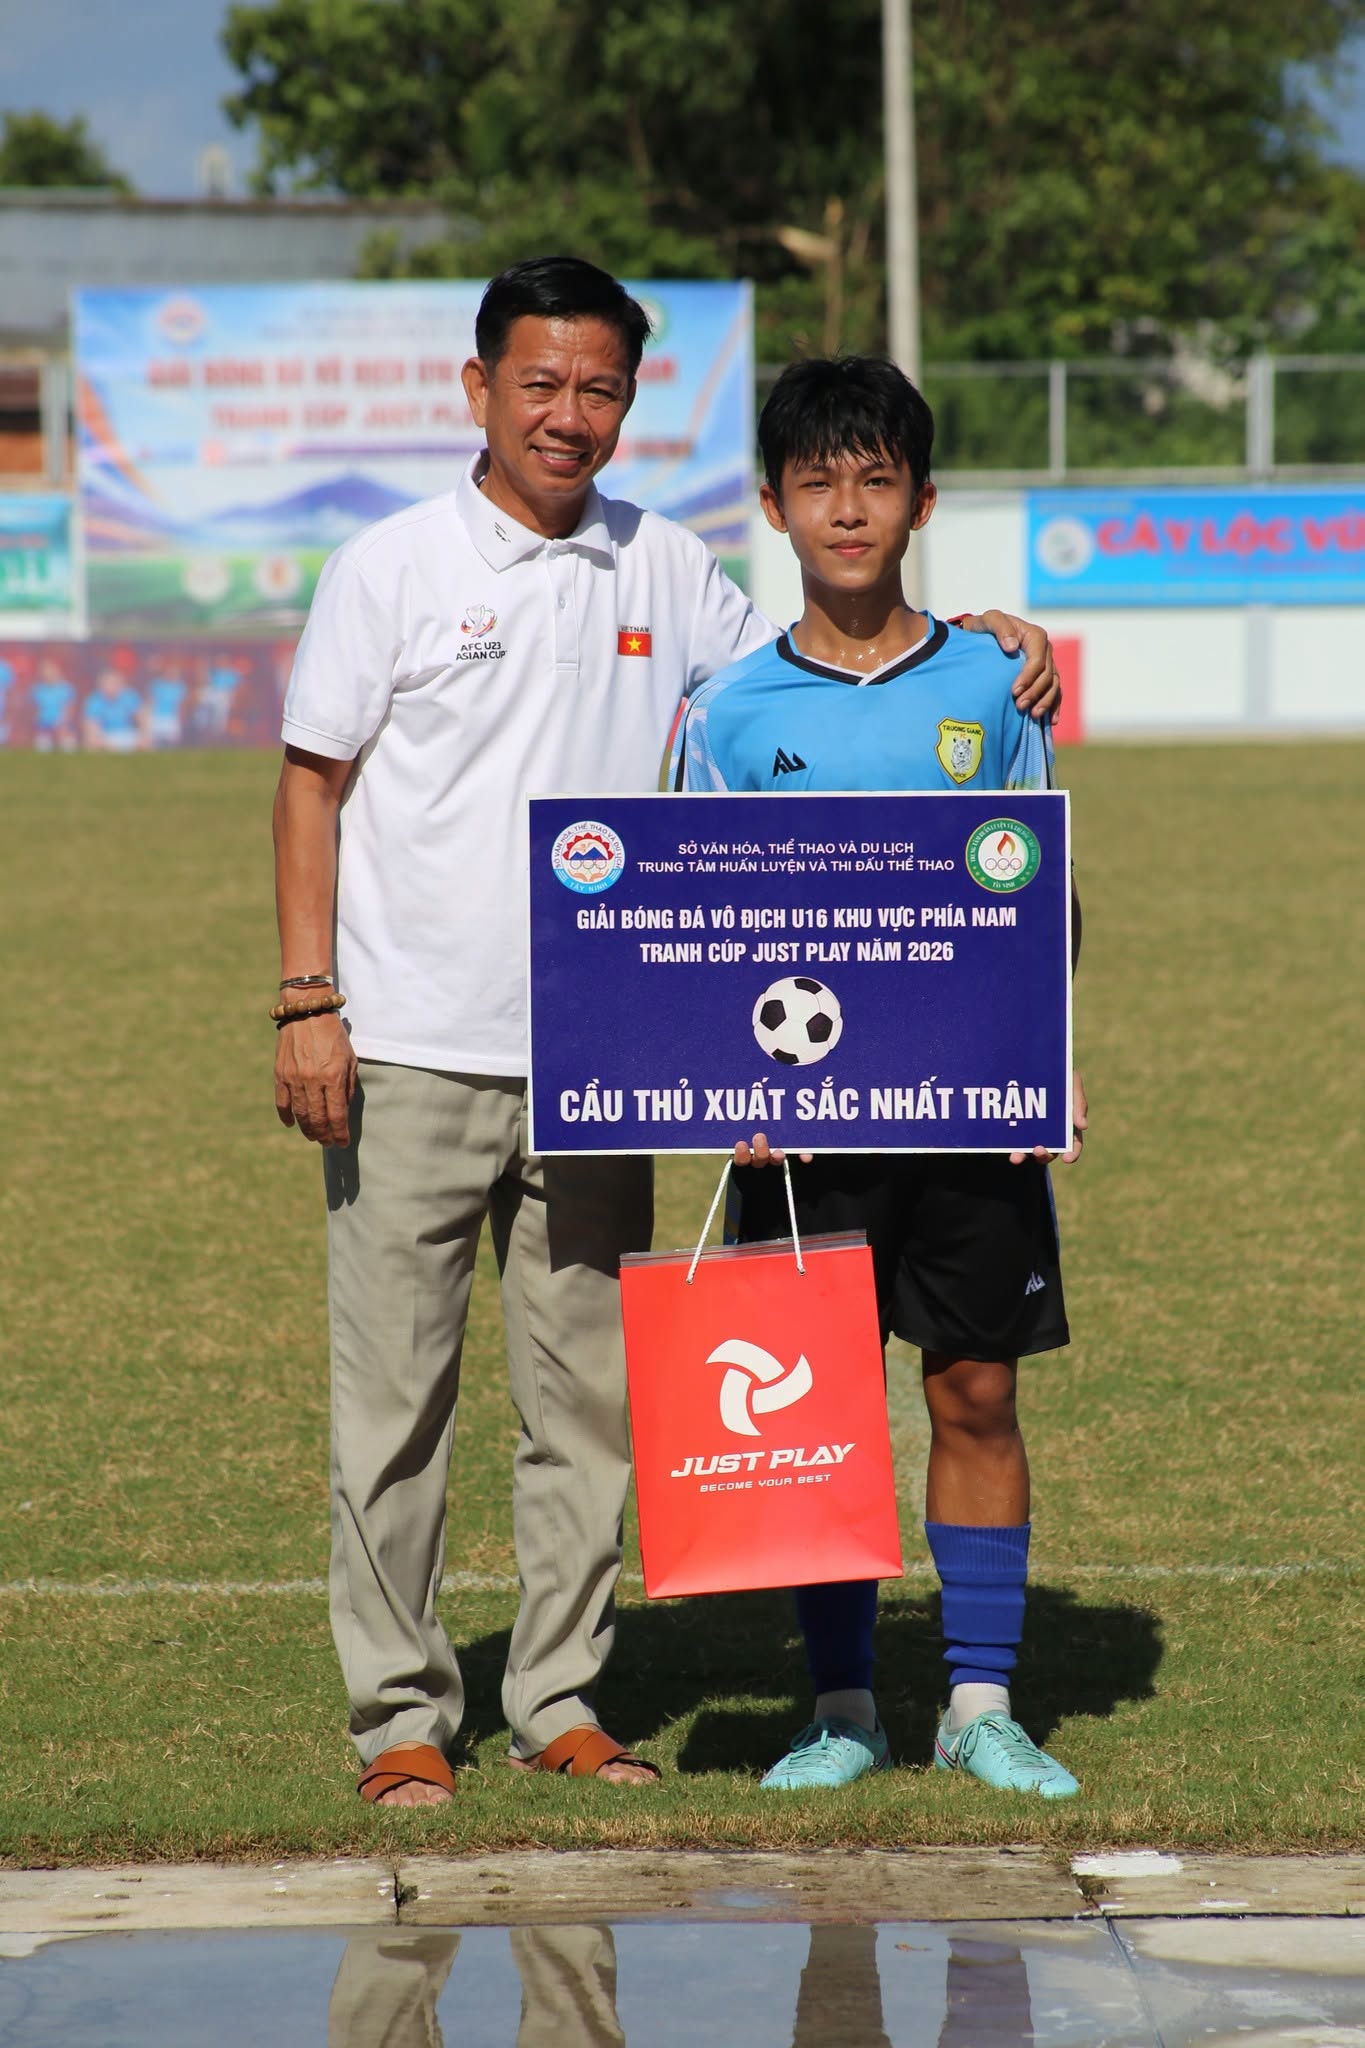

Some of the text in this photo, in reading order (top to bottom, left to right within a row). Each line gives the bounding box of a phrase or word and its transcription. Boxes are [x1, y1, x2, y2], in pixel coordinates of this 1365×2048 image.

[456, 650, 506, 660] ASIAN CUP
[461, 641, 501, 651] AFC U23
[678, 838, 914, 856] SỞ VĂN HÓA, THỂ THAO VÀ DU LỊCH
[637, 855, 955, 874] TRUNG TÂM HUẤN LUYỆN VÀ THI ĐẤU THỂ THAO
[576, 903, 1016, 933] GIẢI BÓNG ĐÁ VÔ ĐỊCH U16 KHU VỰC PHÍA NAM
[640, 938, 954, 963] TRANH CÚP JUST PLAY NĂM 2026
[559, 1076, 1047, 1127] CẦU THỦ XUẤT SẮC NHẤT TRẬN
[670, 1443, 856, 1478] JUST PLAY
[700, 1474, 831, 1493] BECOME YOUR BEST
